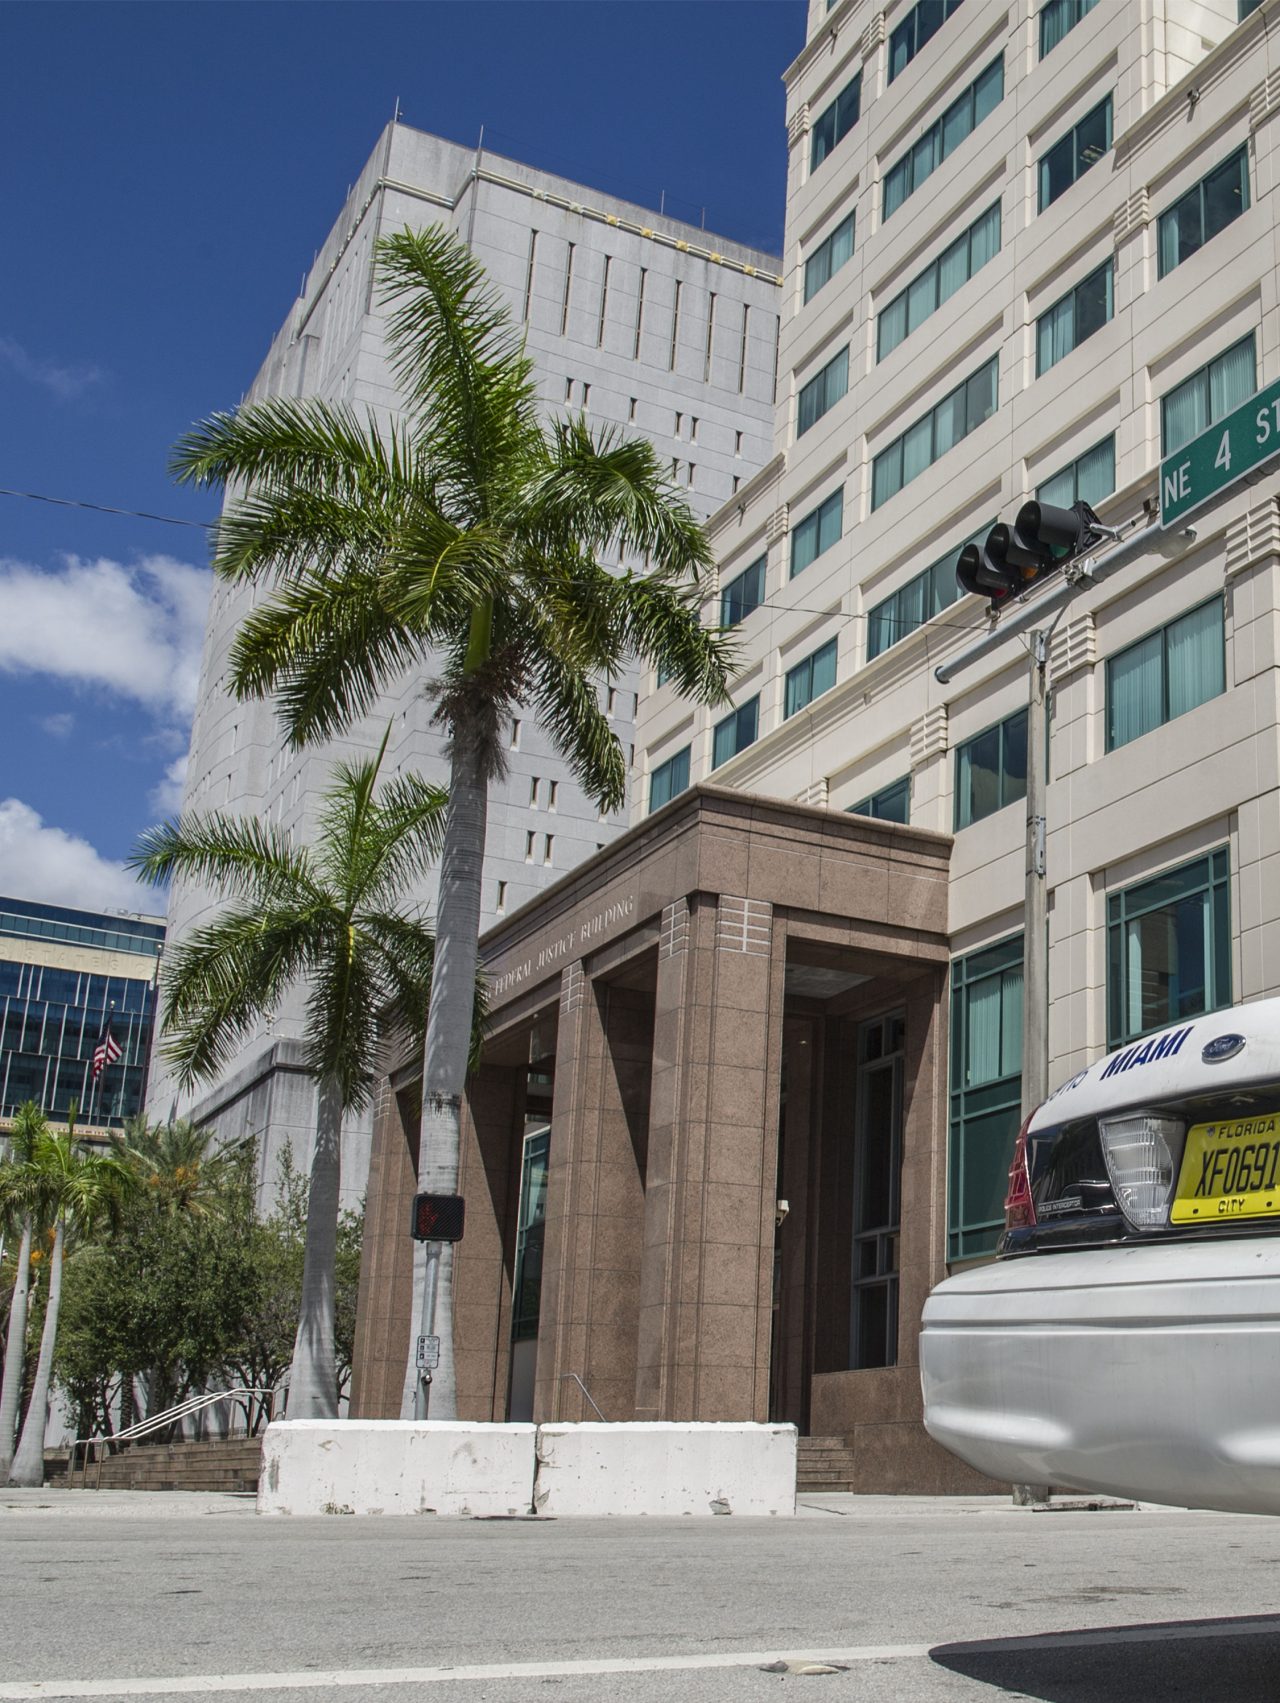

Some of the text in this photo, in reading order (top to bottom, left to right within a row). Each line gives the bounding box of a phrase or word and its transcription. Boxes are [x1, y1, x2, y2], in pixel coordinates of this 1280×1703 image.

[1164, 460, 1192, 509] NE
[1214, 429, 1232, 472] 4
[536, 930, 577, 971] JUSTICE
[581, 894, 634, 942] BUILDING
[1099, 1025, 1195, 1081] MIAMI
[1218, 1119, 1276, 1139] FLORIDA
[1217, 1199, 1246, 1214] CITY
